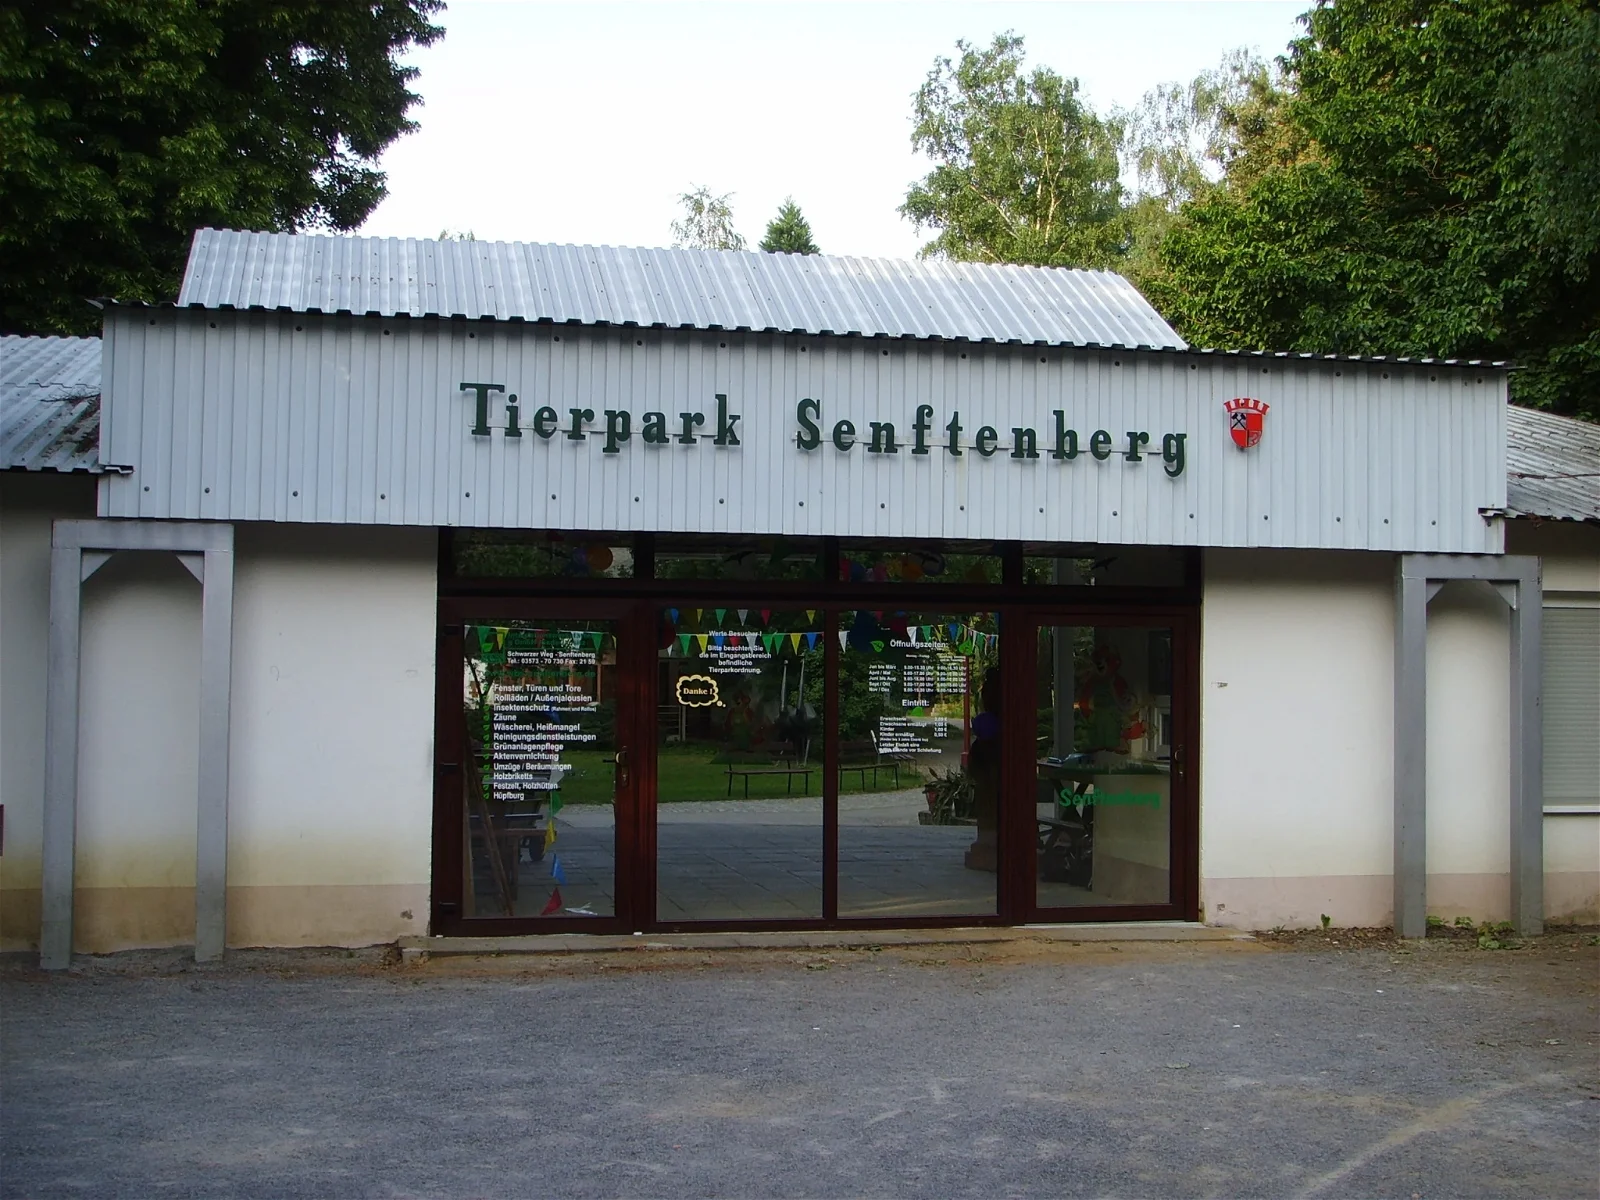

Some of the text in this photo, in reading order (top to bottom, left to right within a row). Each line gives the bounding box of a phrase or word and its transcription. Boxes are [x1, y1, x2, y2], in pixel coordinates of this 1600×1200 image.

[460, 382, 1187, 477] Tierpark Senftenberg
[890, 638, 948, 649] Öffnungszeiten:
[540, 650, 553, 658] Weg
[494, 684, 581, 693] Fenster, Türen und Tore
[902, 699, 930, 707] Eintritt:
[493, 713, 517, 721] Zäune
[493, 723, 580, 732] Wäscherei, Heißmangel
[493, 733, 597, 742] Reinigungsdienstleistungen
[493, 743, 564, 752] Grünanlagenpflege
[493, 752, 559, 761] Aktenvernichtung
[493, 763, 520, 771] Umzüge
[525, 763, 572, 771] Beräumungen
[493, 782, 521, 790] Festzelt,
[493, 792, 525, 801] Hüpfburg
